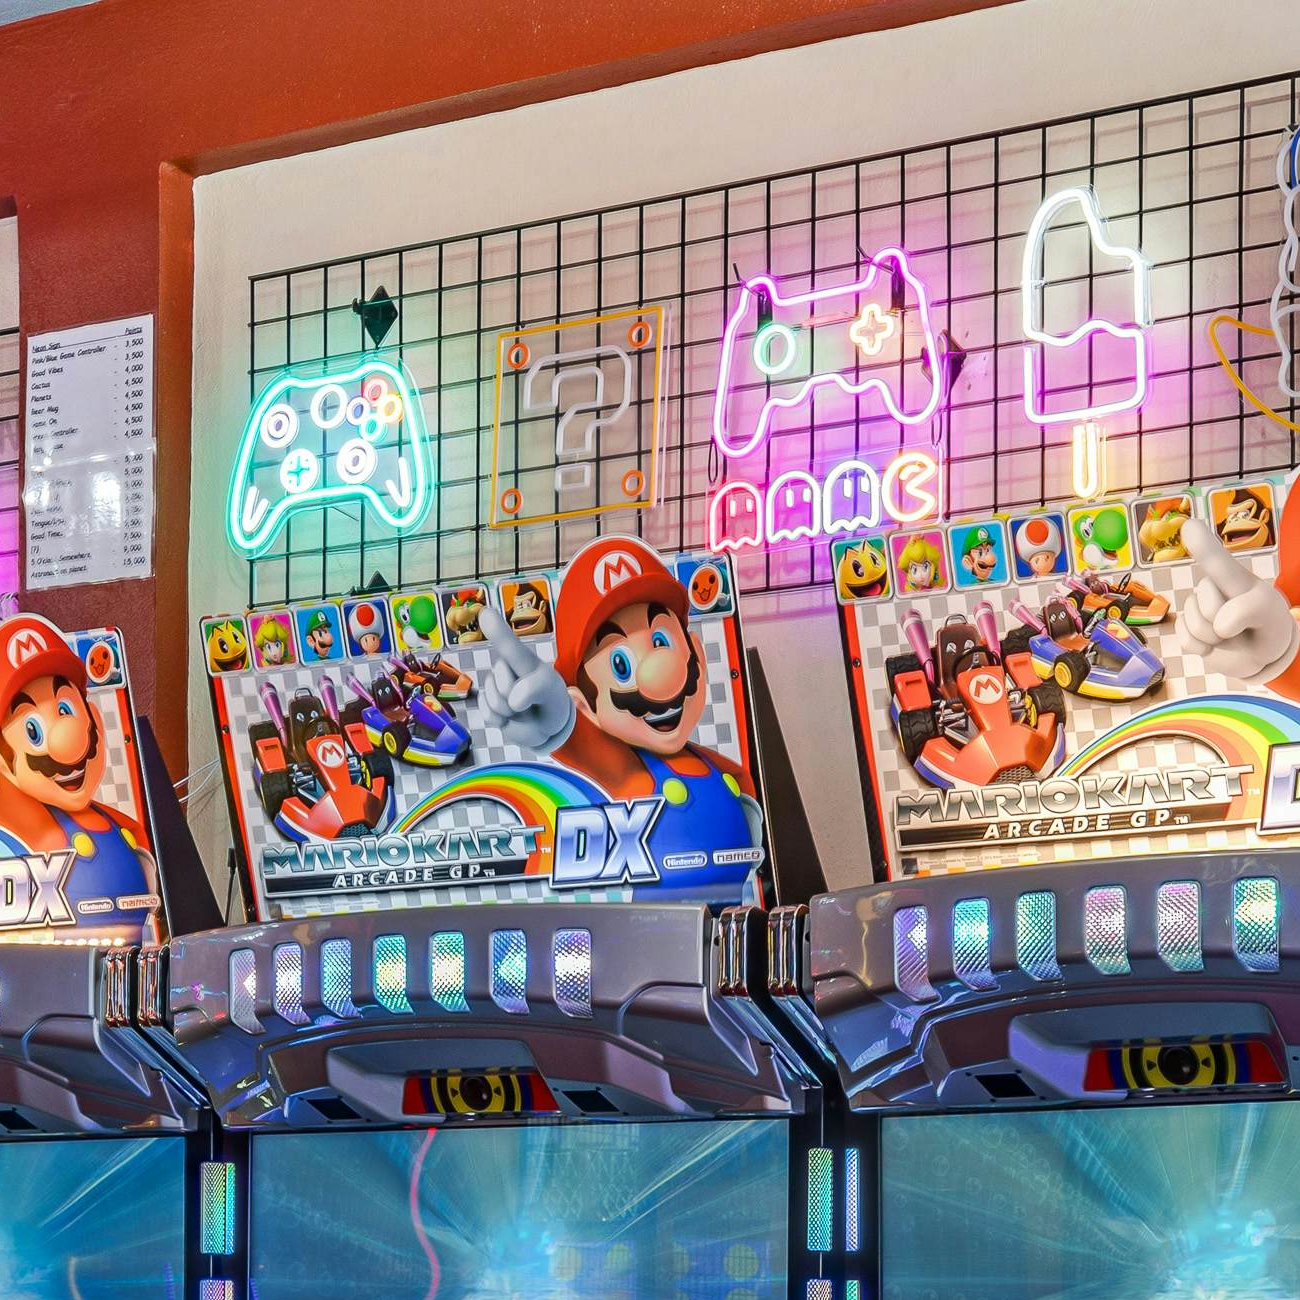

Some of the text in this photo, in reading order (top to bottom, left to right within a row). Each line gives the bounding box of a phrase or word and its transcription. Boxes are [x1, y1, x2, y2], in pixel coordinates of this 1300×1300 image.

[125, 338, 143, 348] 3,500
[125, 350, 143, 360] 3,500
[125, 376, 143, 386] 4,500
[125, 390, 143, 399] 4,500
[983, 813, 1115, 839] ARCADE
[551, 797, 664, 886] DX
[665, 849, 762, 867] Nintendo namco
[332, 863, 435, 888] ARCADE
